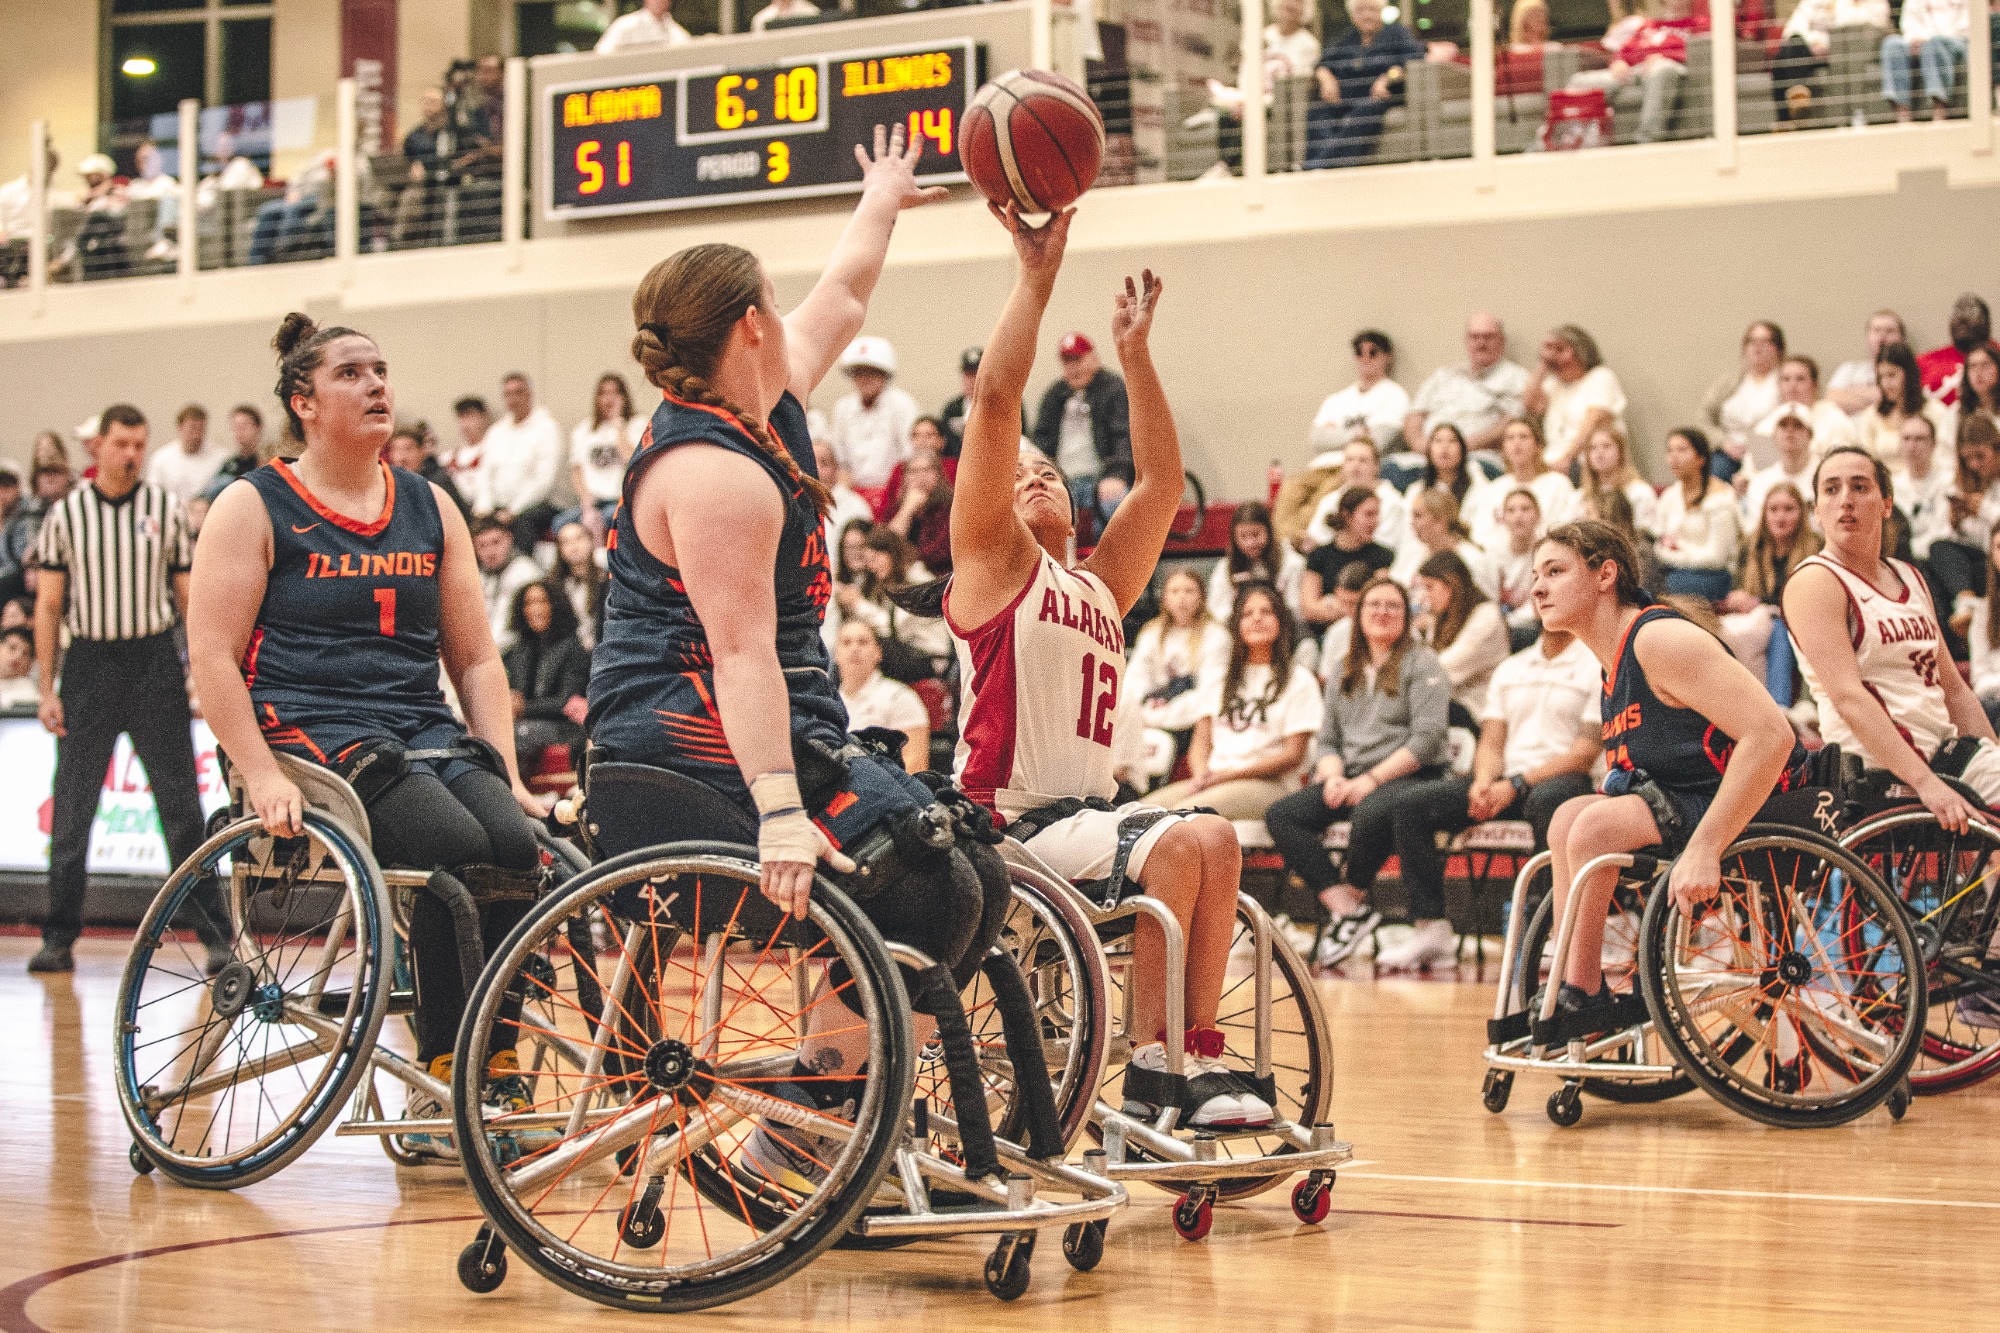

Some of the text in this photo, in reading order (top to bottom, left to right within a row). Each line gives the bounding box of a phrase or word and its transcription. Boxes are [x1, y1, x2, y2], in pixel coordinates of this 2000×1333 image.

[715, 67, 817, 129] 6:10
[908, 107, 953, 156] 14
[575, 140, 632, 195] 51
[767, 141, 791, 184] 3
[305, 552, 437, 579] ILLINOIS
[373, 588, 397, 637] 1
[1039, 587, 1126, 655] ALABAM
[1076, 652, 1118, 748] 12
